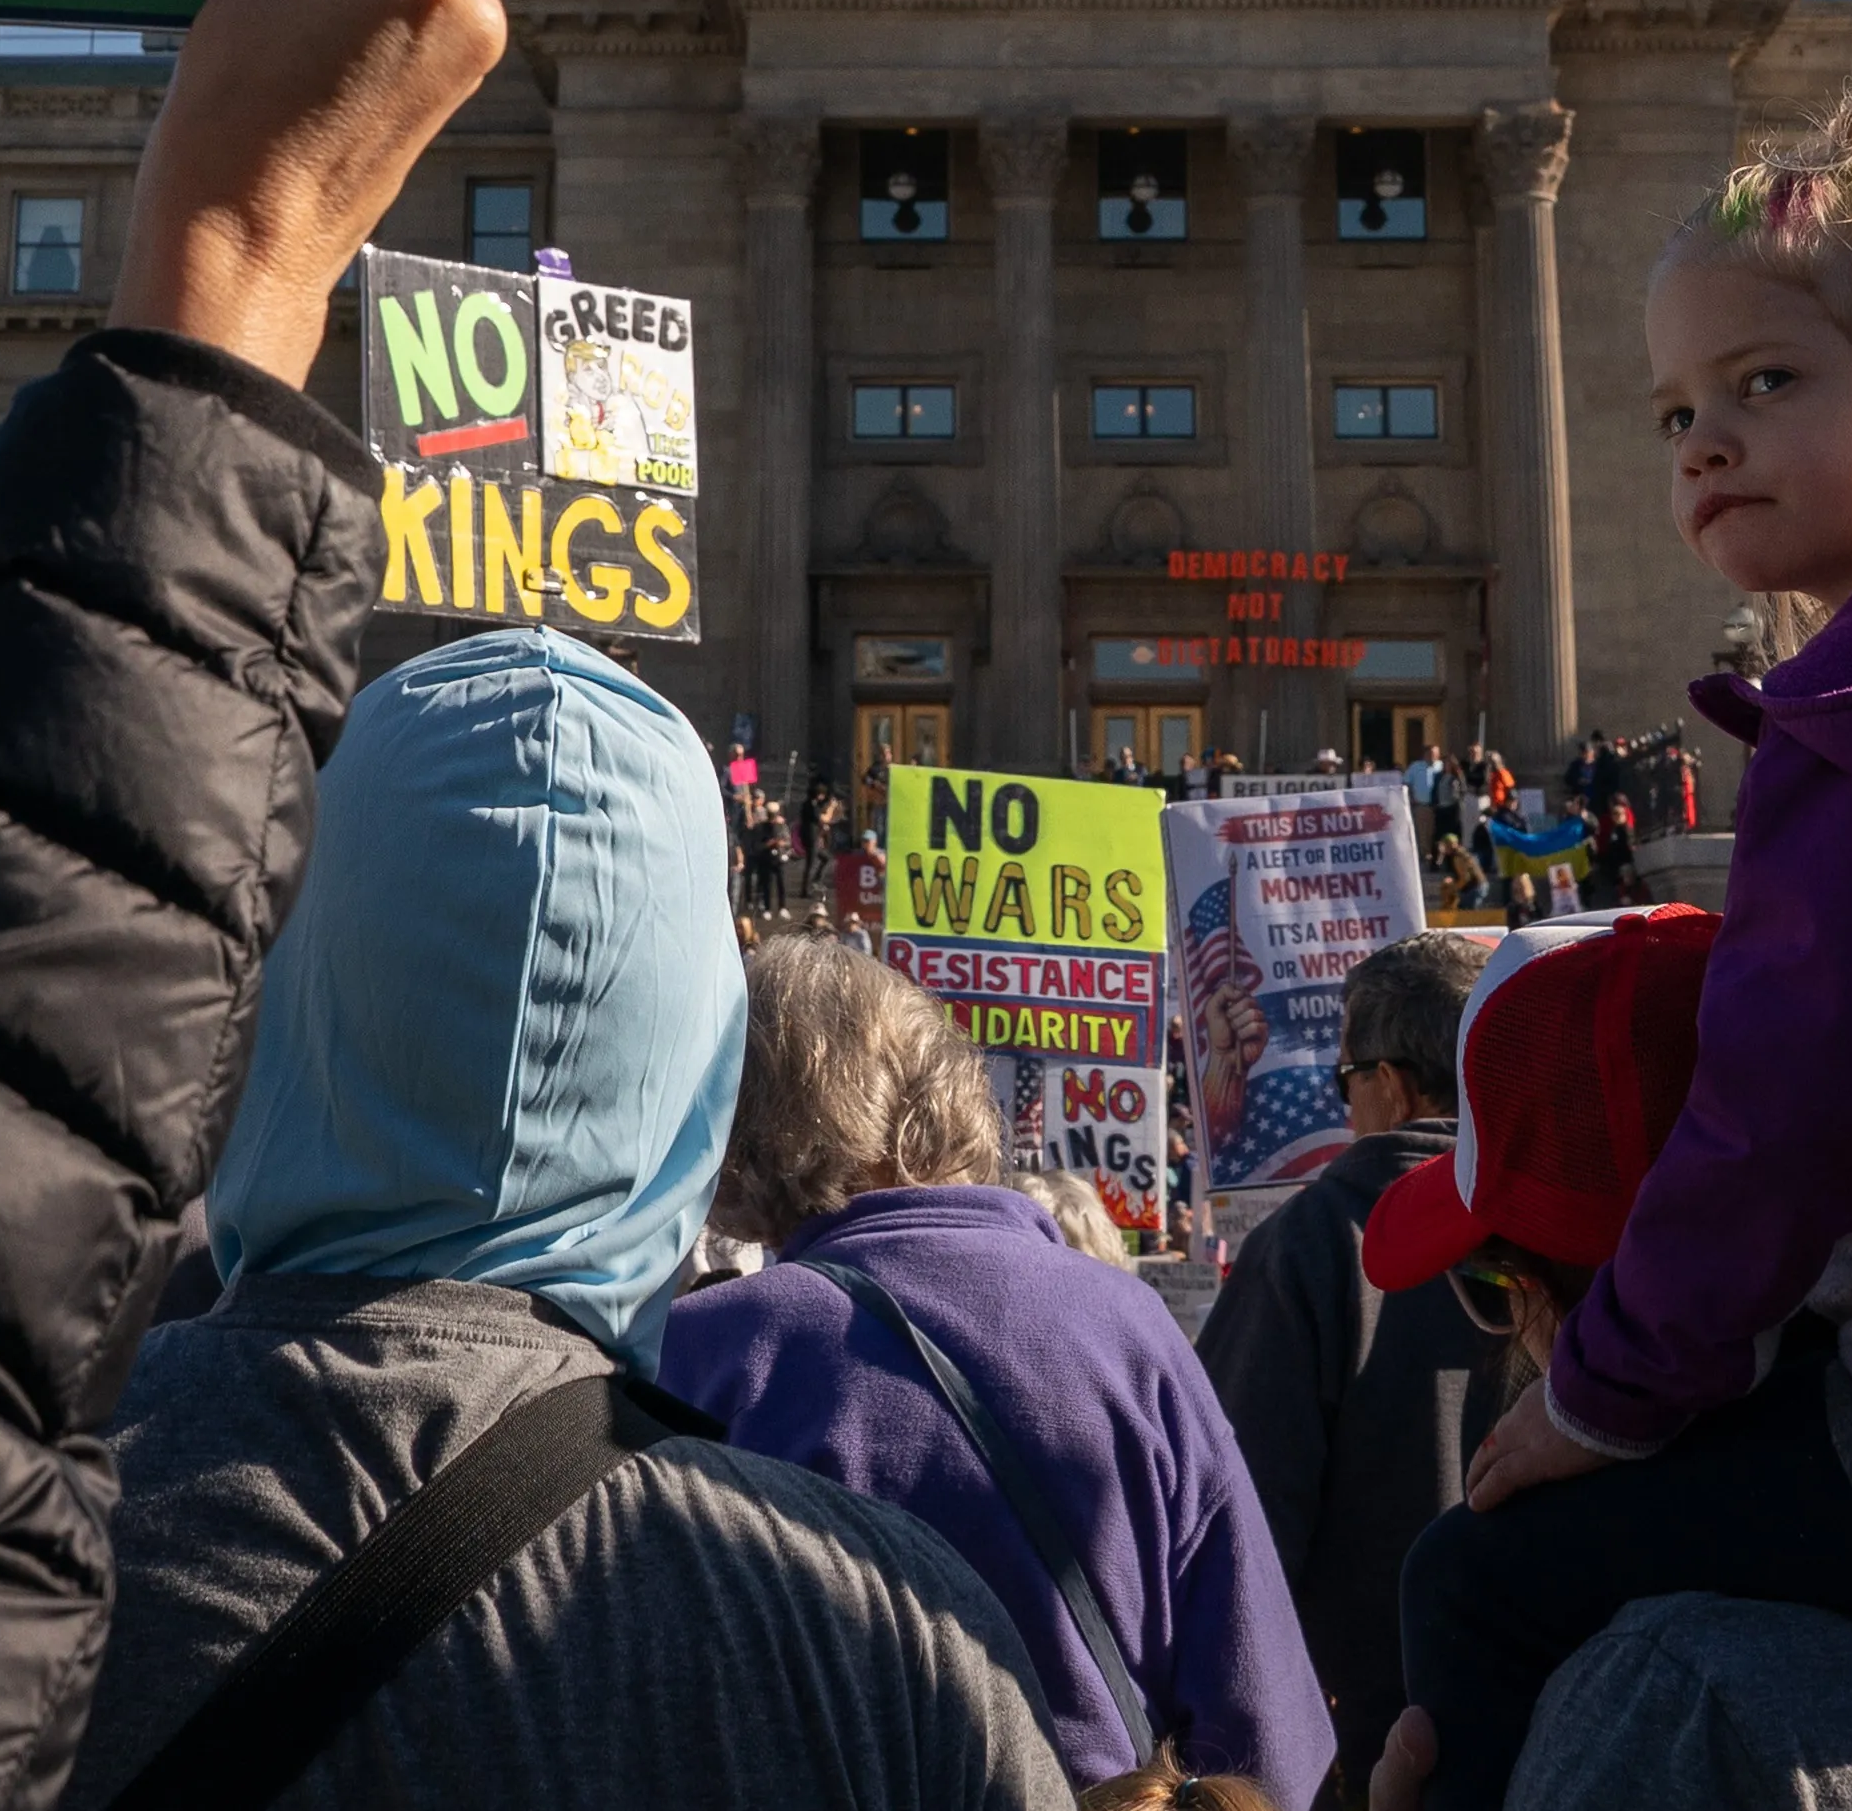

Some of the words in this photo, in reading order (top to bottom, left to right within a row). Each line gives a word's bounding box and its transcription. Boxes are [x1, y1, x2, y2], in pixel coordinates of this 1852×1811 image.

[544, 290, 689, 354] GREED
[378, 288, 528, 427] NO
[619, 350, 692, 432] ROB
[635, 456, 694, 490] POOR
[380, 463, 692, 629] KINGS
[1167, 549, 1349, 583] DEMOCRACY
[1227, 591, 1284, 622] NOT
[1156, 637, 1367, 668] DICTATORSHIP
[928, 775, 1040, 856] NO
[1243, 816, 1293, 839] THIS
[1297, 814, 1318, 835] IS
[1321, 810, 1366, 833] NOT
[1247, 850, 1260, 871] A
[1261, 847, 1301, 870] LEFT
[1305, 848, 1326, 865] OR
[1330, 840, 1386, 865] RIGHT
[906, 851, 1143, 943] WARS
[1260, 870, 1383, 905] MOMENT,
[1305, 921, 1319, 943] A
[1320, 915, 1390, 944] RIGHT
[886, 938, 1150, 1003] RESISTANCE
[1272, 959, 1298, 980] OR
[1287, 994, 1346, 1021] MOM
[1062, 1066, 1147, 1124] NO
[1048, 1124, 1157, 1192] INGS
